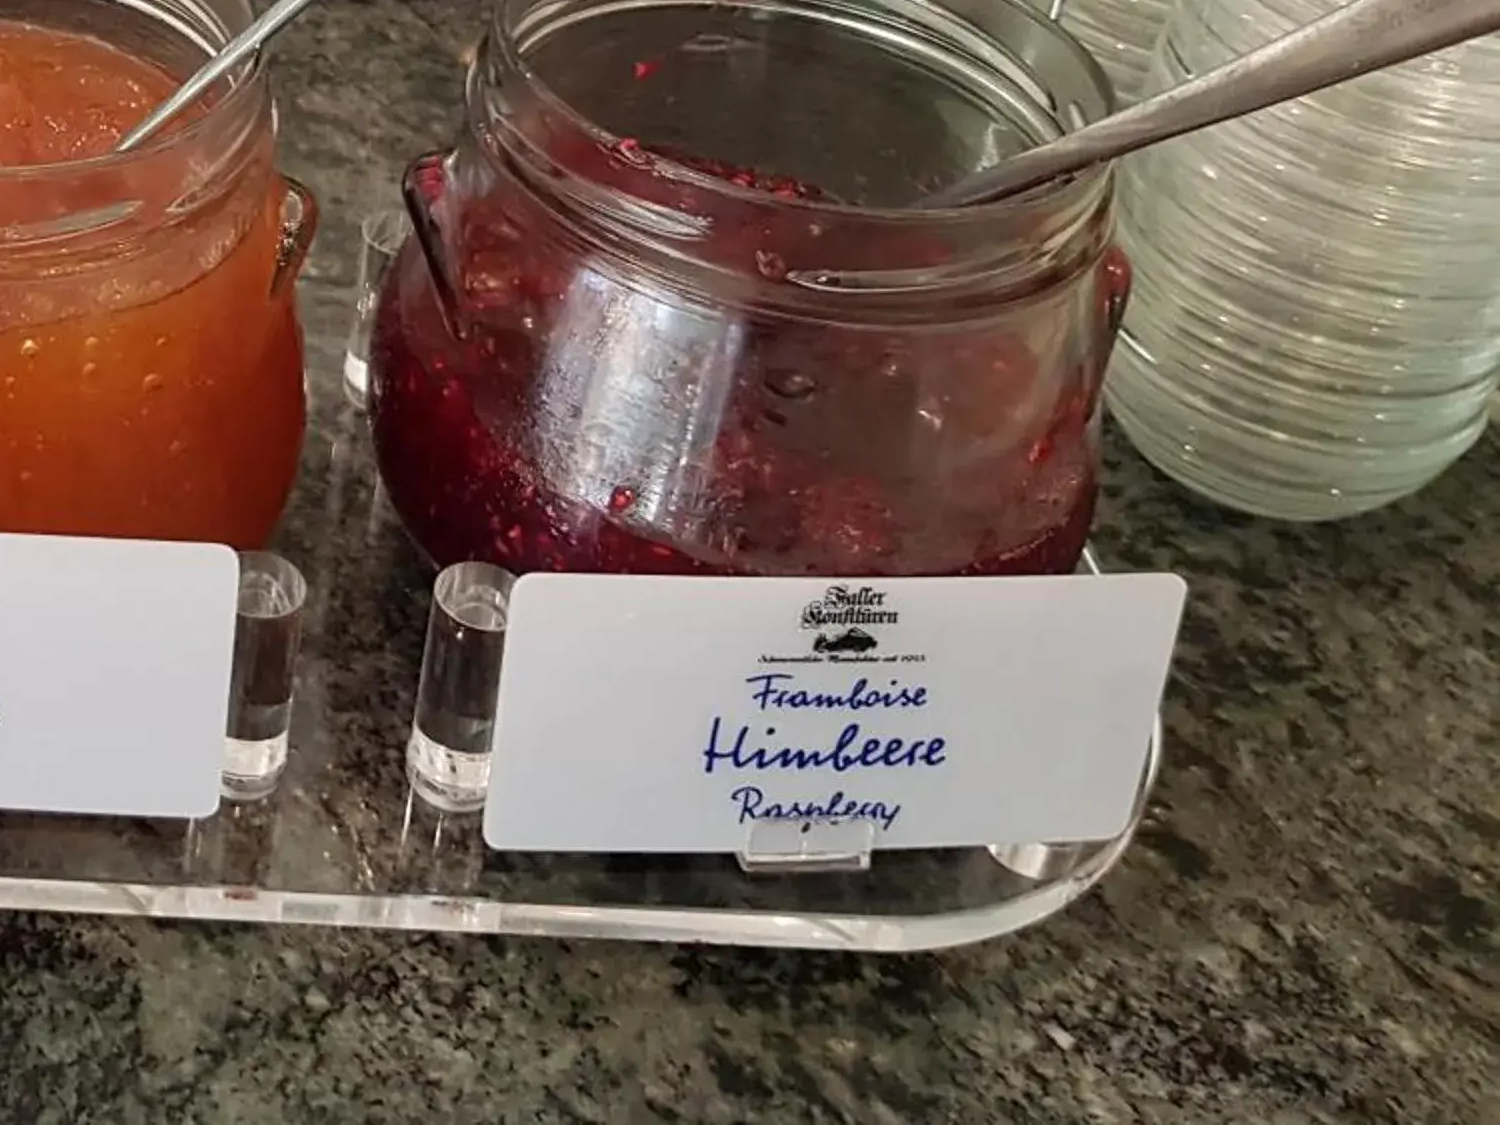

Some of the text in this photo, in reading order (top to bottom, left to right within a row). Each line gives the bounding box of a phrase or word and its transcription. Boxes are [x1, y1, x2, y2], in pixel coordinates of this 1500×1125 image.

[823, 584, 887, 608] Faller
[744, 673, 928, 712] Framboise
[702, 716, 947, 774] Himbeere
[730, 785, 902, 834] Raspberry
